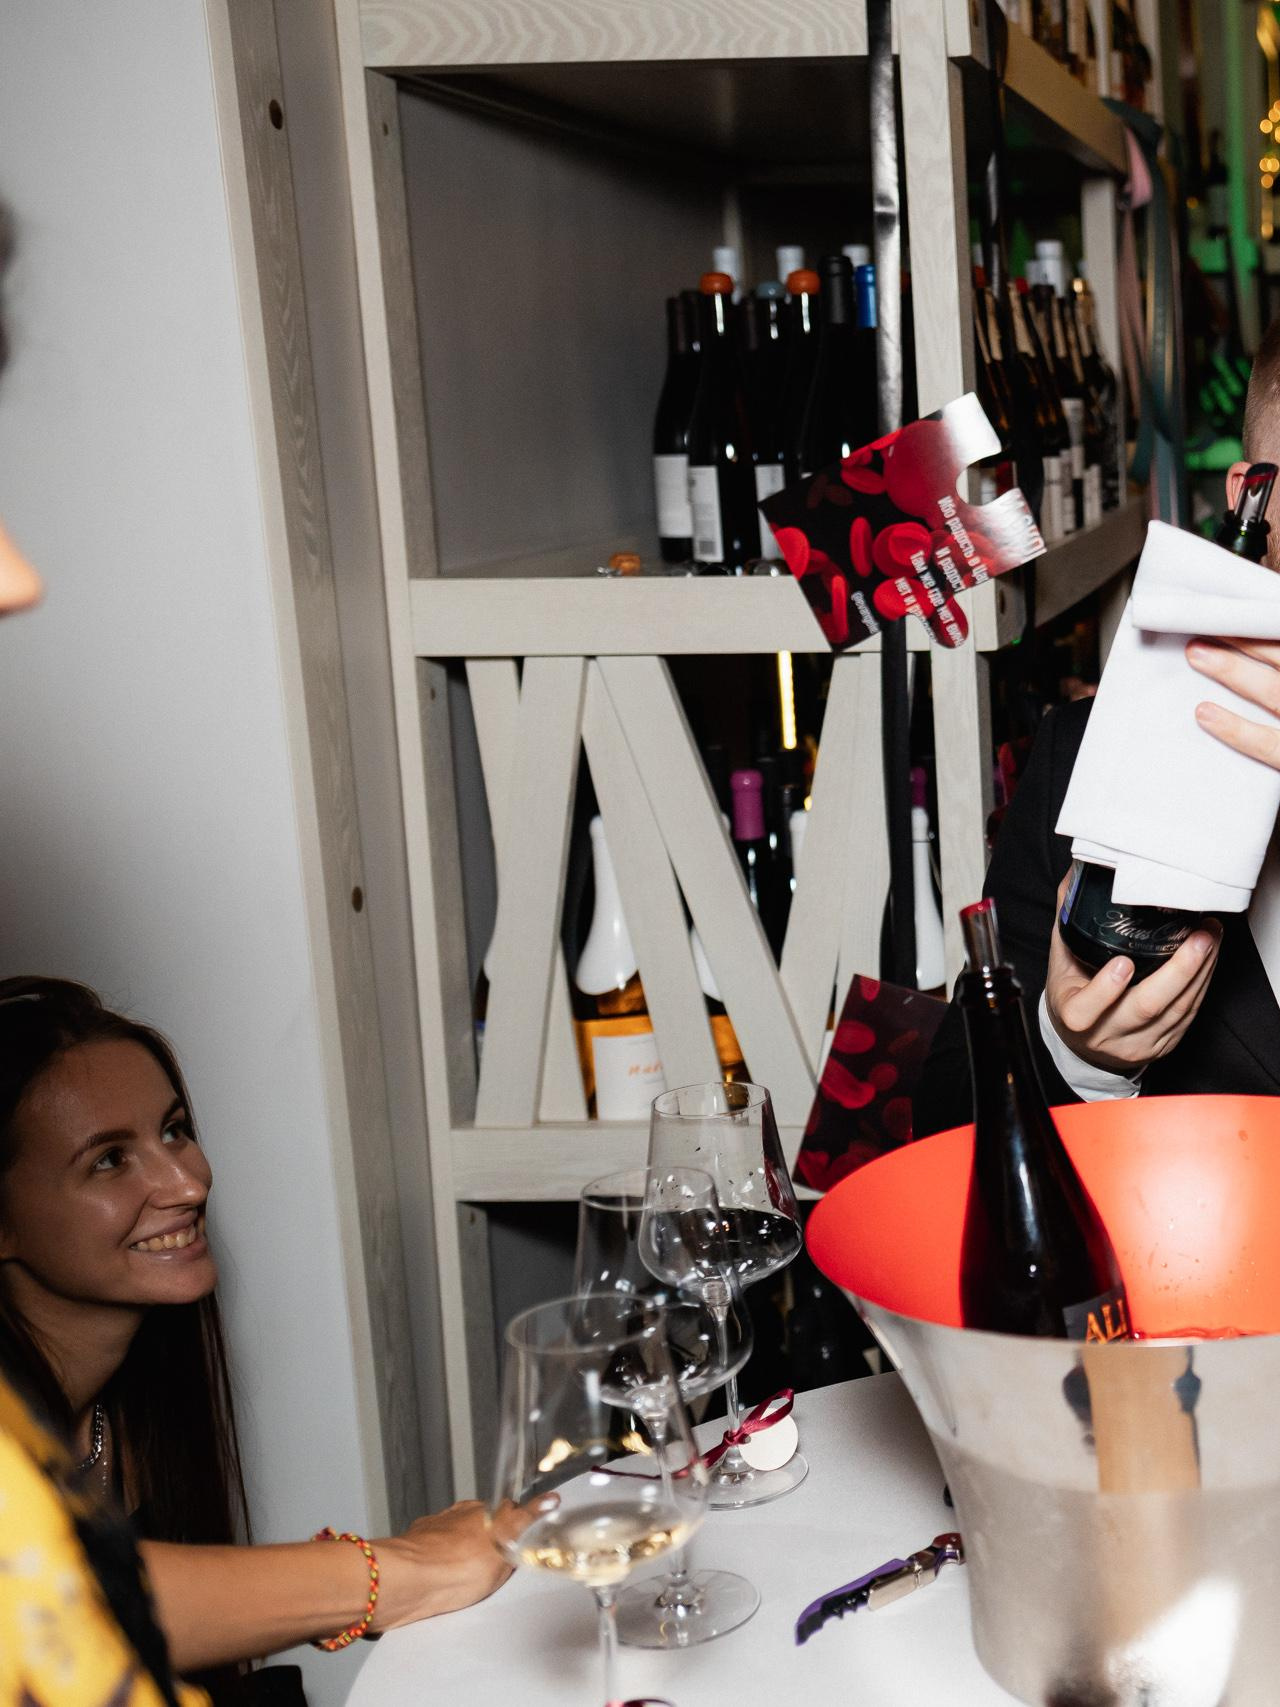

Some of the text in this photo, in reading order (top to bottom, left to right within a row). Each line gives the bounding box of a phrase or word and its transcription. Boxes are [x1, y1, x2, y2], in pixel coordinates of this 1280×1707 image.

[937, 494, 957, 519] Ибо
[944, 516, 974, 559] радость
[935, 546, 950, 558] И
[967, 556, 979, 568] в
[893, 576, 916, 606] нет и
[910, 549, 927, 573] Там
[919, 571, 936, 590] же
[928, 586, 944, 607] где
[936, 605, 954, 625] нет
